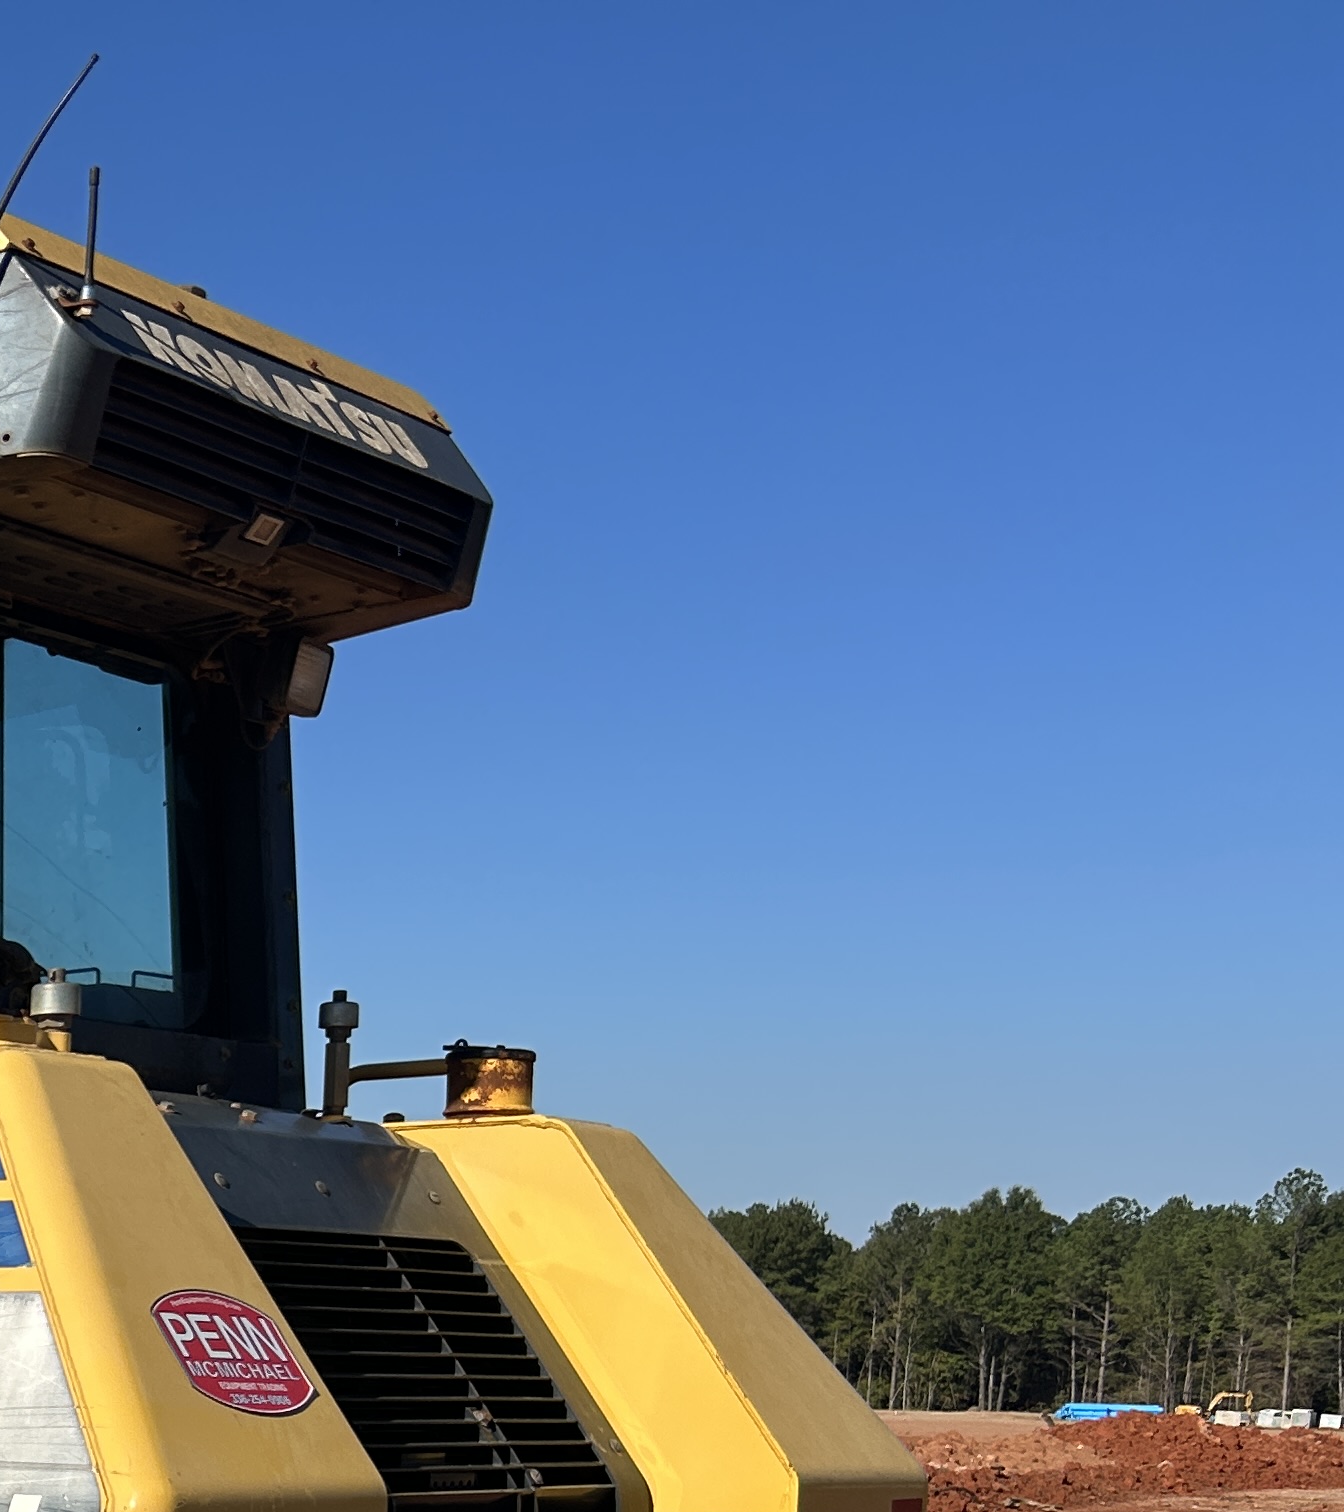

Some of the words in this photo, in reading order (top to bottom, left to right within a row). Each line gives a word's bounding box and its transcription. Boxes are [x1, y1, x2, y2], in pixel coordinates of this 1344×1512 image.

[120, 308, 429, 470] KOMATSU
[158, 1311, 288, 1362] PENN
[185, 1360, 302, 1381] MCMICHAEL
